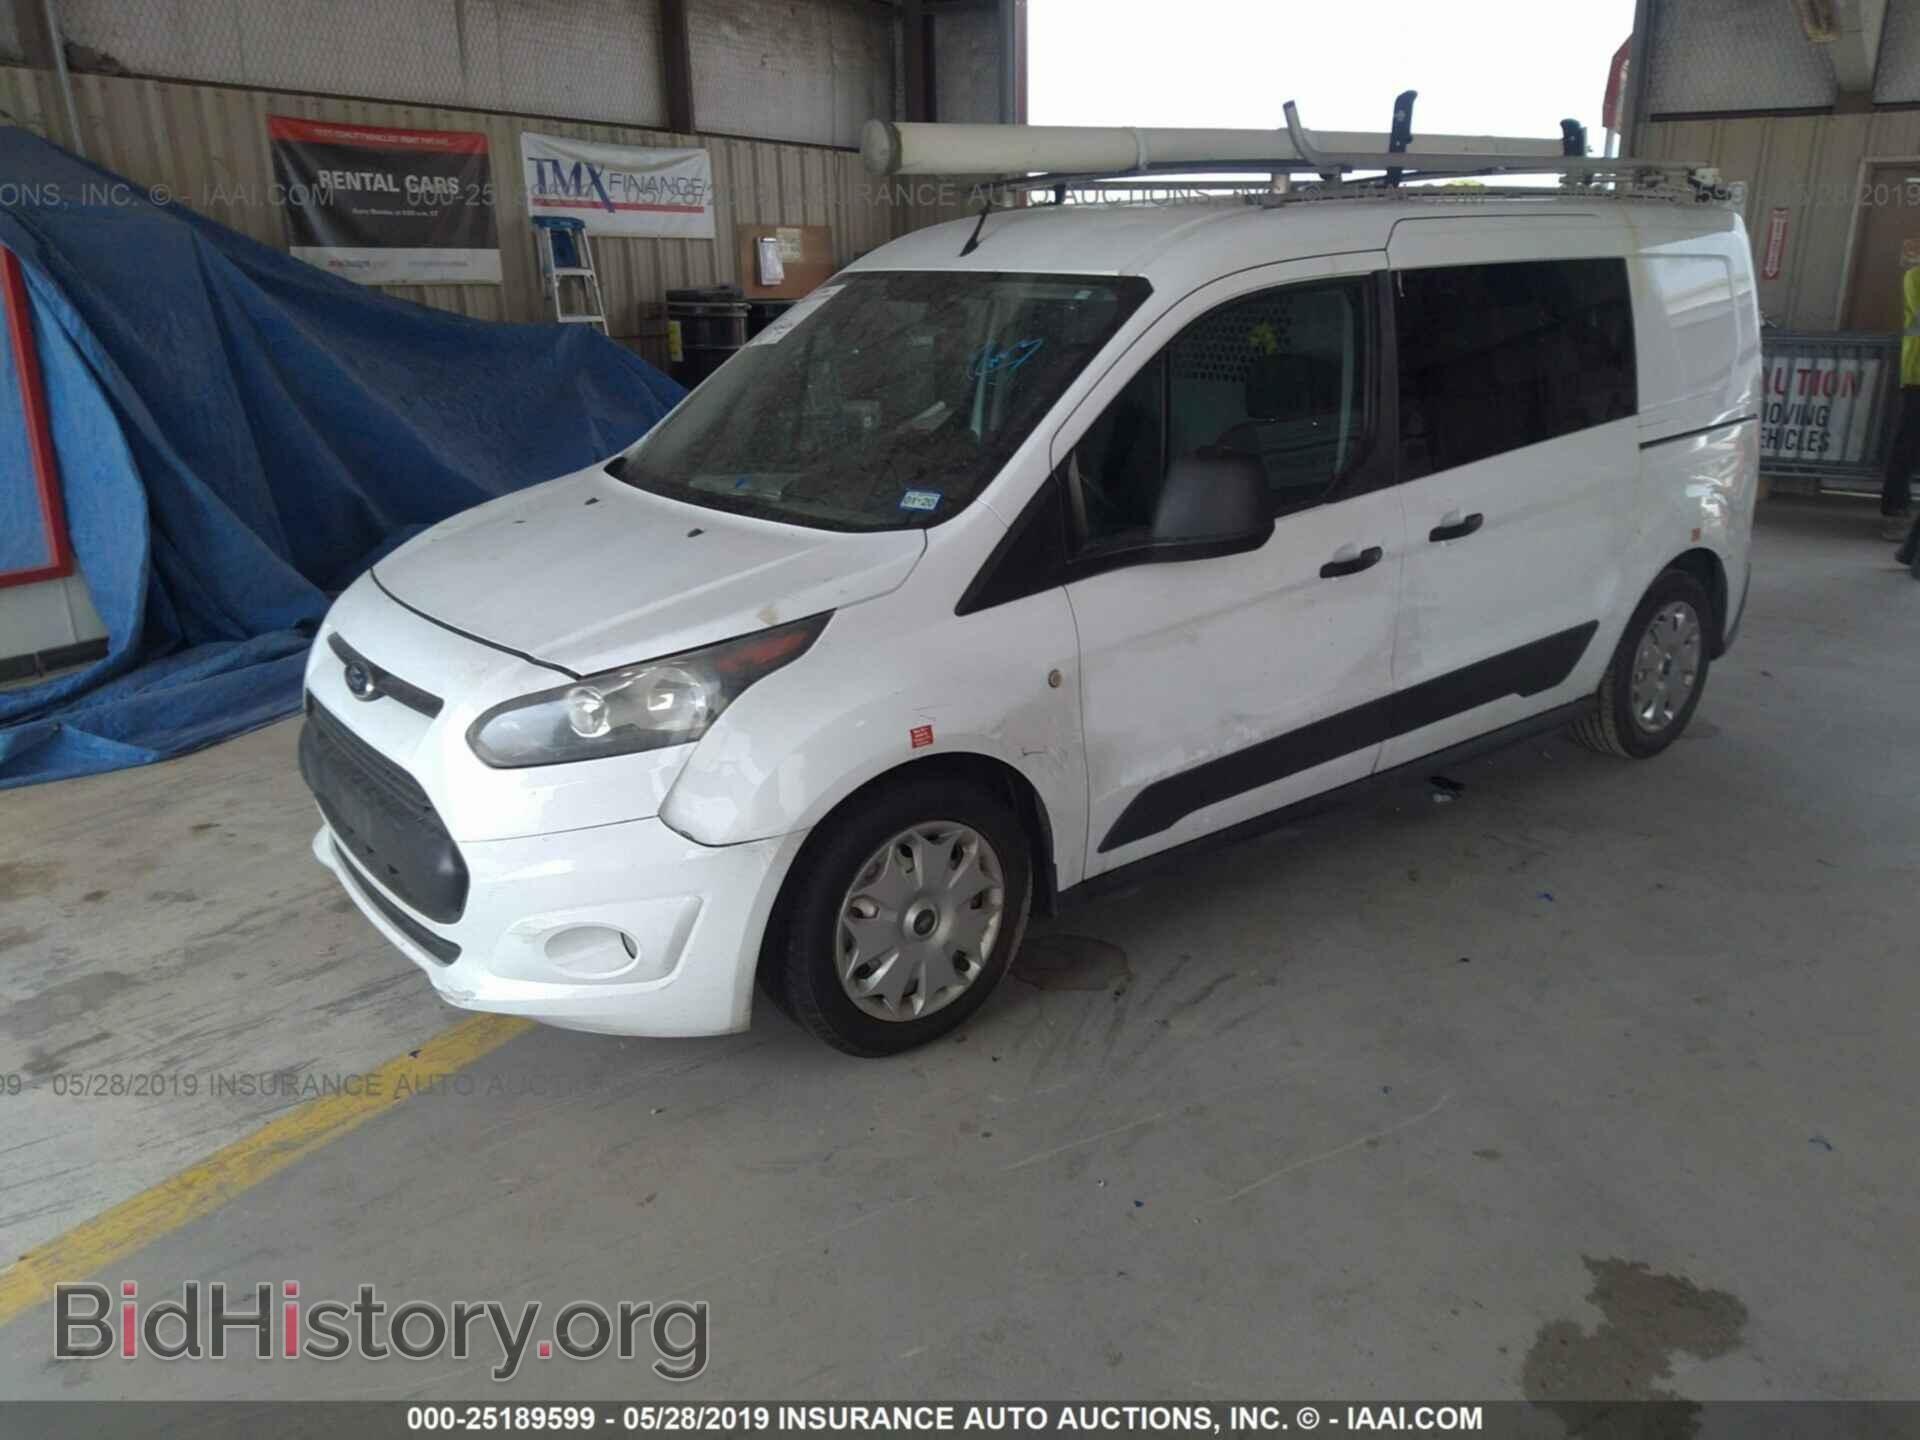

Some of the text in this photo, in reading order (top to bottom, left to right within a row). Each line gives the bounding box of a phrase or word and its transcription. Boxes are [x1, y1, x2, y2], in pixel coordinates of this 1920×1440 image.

[317, 169, 460, 195] RENTAL CARS
[528, 156, 705, 213] TMX FINANCE
[1760, 427, 1831, 453] EHICLES
